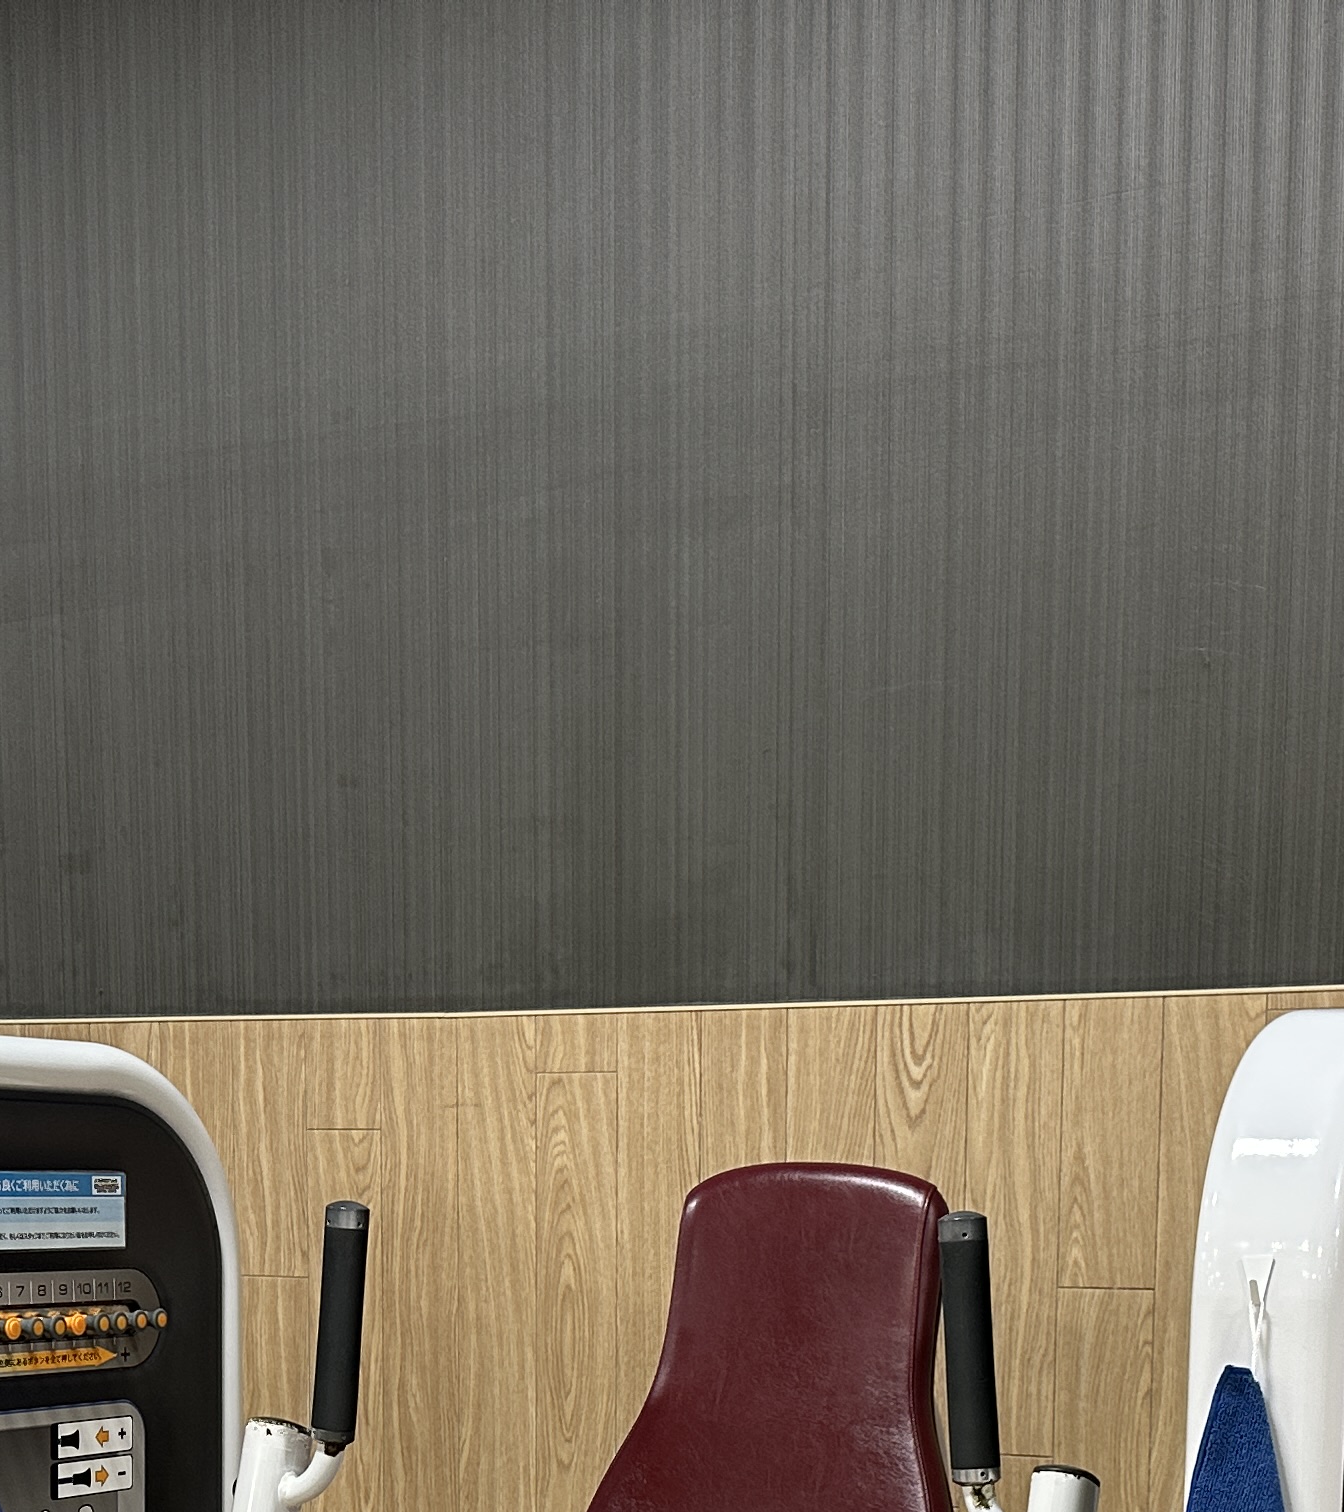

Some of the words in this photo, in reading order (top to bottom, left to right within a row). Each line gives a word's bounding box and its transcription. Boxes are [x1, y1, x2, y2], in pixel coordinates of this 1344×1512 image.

[16, 1286, 24, 1297] 7
[38, 1285, 47, 1296] 8
[59, 1284, 68, 1295] 9
[77, 1283, 91, 1295] 10
[98, 1282, 109, 1293] 11
[118, 1282, 131, 1292] 12
